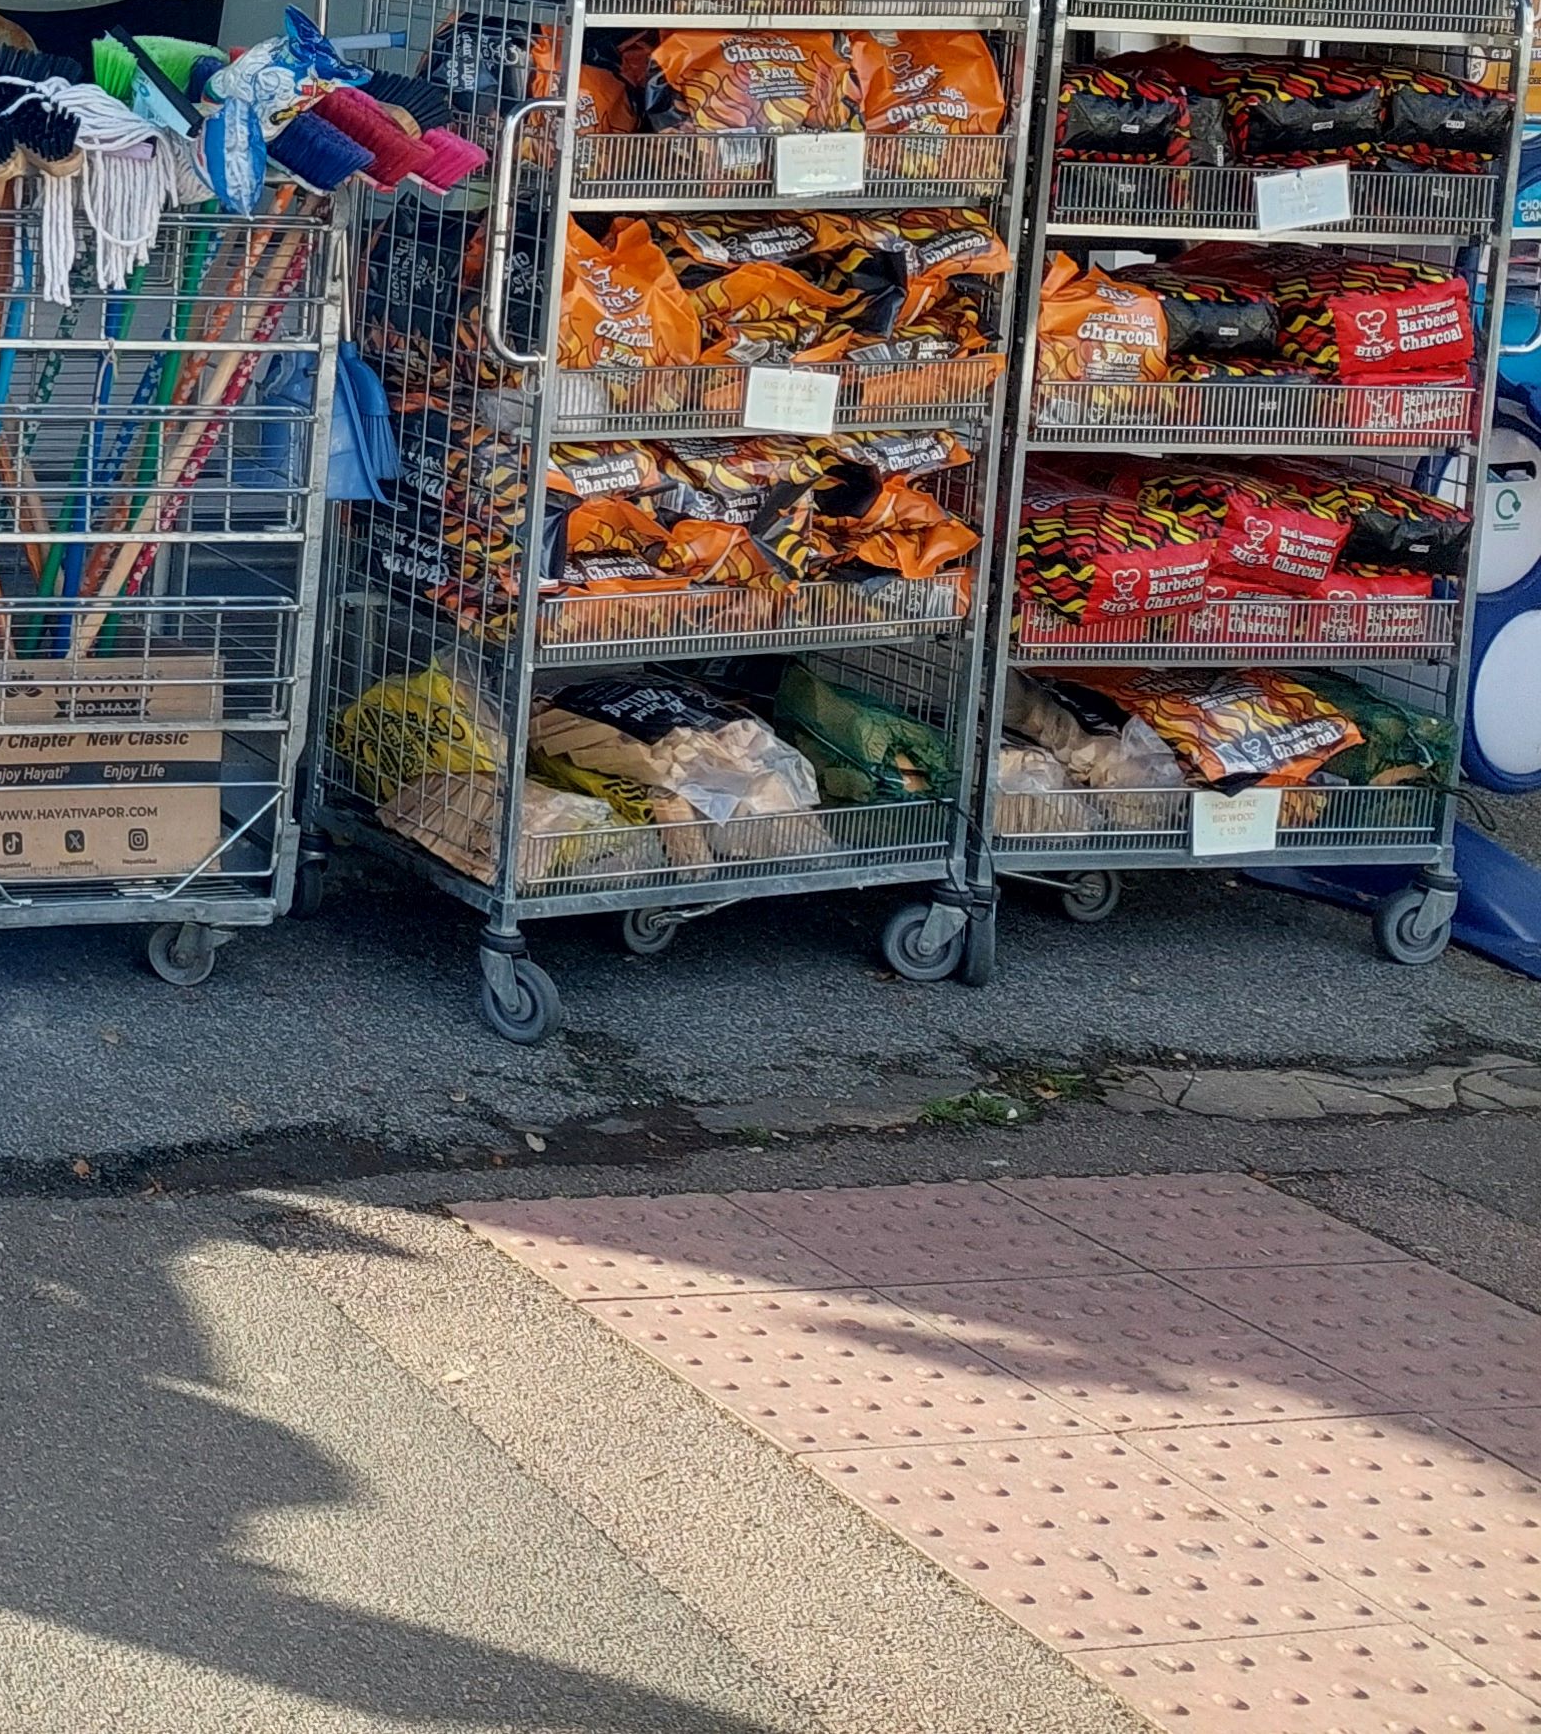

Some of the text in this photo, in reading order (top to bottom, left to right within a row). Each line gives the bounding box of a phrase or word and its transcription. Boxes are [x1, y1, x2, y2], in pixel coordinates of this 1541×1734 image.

[722, 45, 807, 63] Charcoal
[749, 67, 799, 80] 2 PACK
[886, 101, 969, 123] Charcoal
[918, 119, 950, 135] PACK
[745, 226, 802, 244] Instant Light
[749, 232, 816, 257] Charcoal
[926, 235, 988, 265] Charcoal
[1396, 306, 1418, 318] Real
[1397, 311, 1460, 335] Barbecue
[1077, 322, 1159, 347] Charcoal
[1399, 328, 1464, 353] Charcoal
[1105, 349, 1142, 365] PACK
[1354, 345, 1386, 357] BIG
[883, 443, 914, 457] Instant
[887, 446, 949, 471] Charcoal
[571, 457, 636, 478] Instant Light
[574, 471, 642, 496] Charcoal
[1279, 526, 1300, 539] Real
[1229, 545, 1258, 565] BIG
[1278, 538, 1334, 562] Barbecue
[580, 557, 612, 568] Instant
[586, 562, 651, 579] Charcoal
[1272, 555, 1327, 581] Charcoal
[1149, 567, 1168, 580] Real
[1148, 575, 1206, 596] Barbecue
[1099, 600, 1128, 614] BIG
[1143, 590, 1204, 611] Charcoal
[7, 733, 77, 751] Chapter
[86, 732, 122, 747] New
[127, 731, 190, 746] Classic
[1272, 726, 1344, 761] Charcoal
[103, 765, 138, 780] Enjoy
[140, 764, 166, 778] Life
